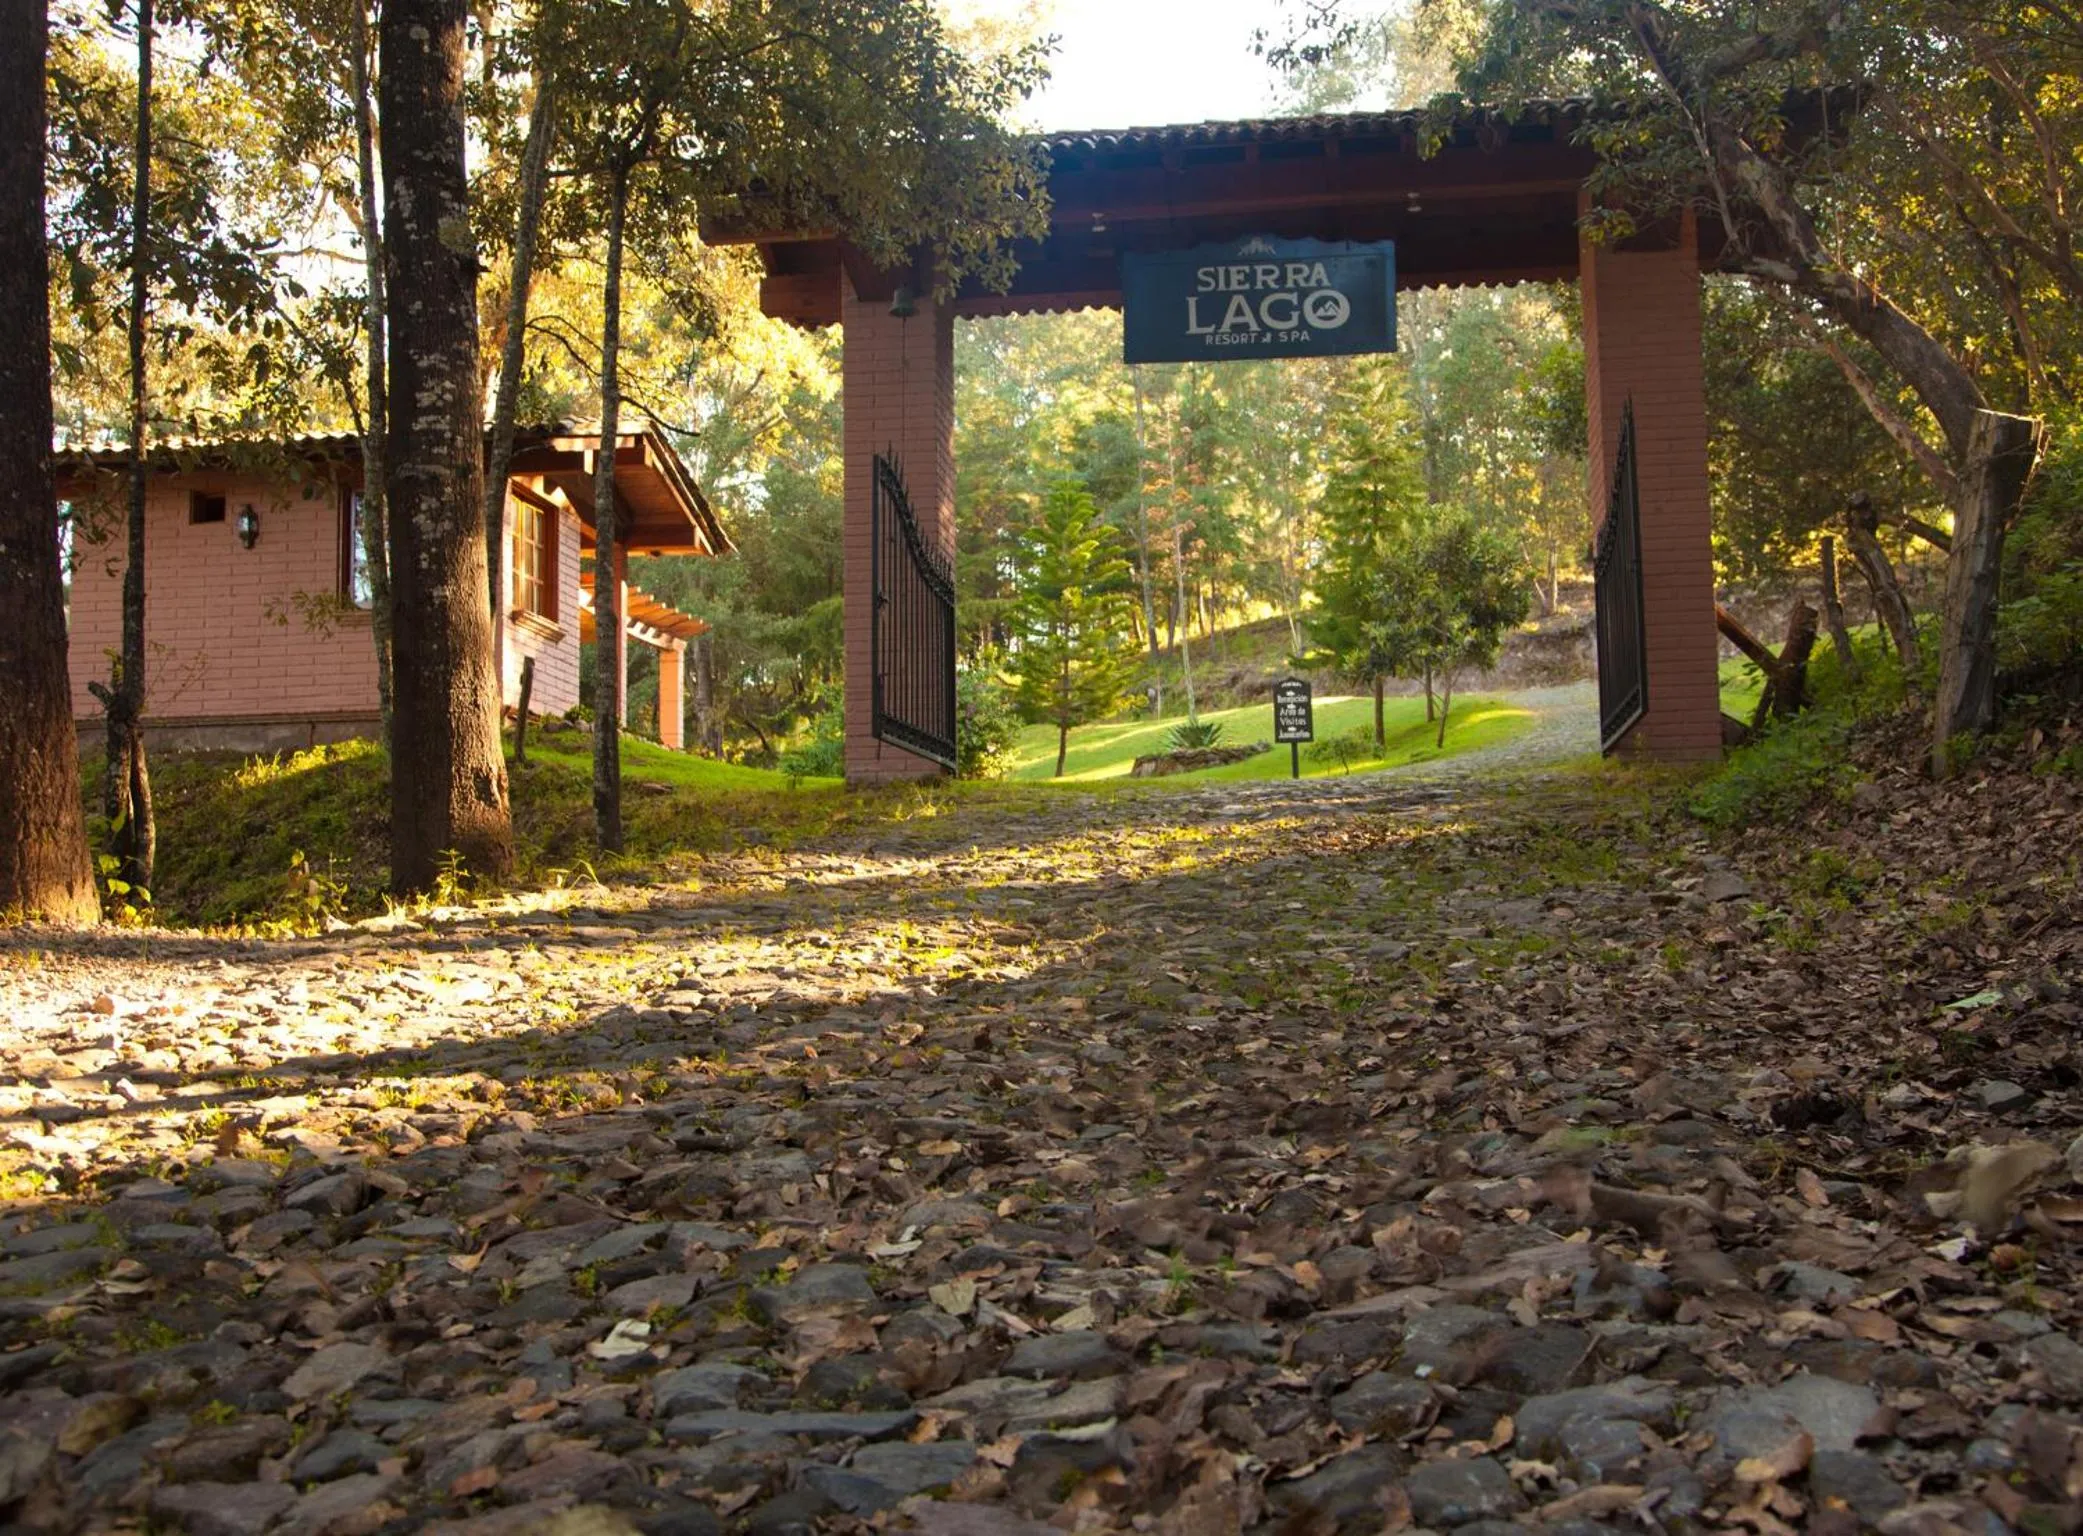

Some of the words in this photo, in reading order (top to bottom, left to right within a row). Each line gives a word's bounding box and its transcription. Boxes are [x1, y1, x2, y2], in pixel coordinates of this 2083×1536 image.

[1197, 262, 1332, 292] SIERRA
[1185, 289, 1350, 335] LAGO
[1206, 332, 1256, 345] RESORT
[1279, 331, 1311, 343] SPA
